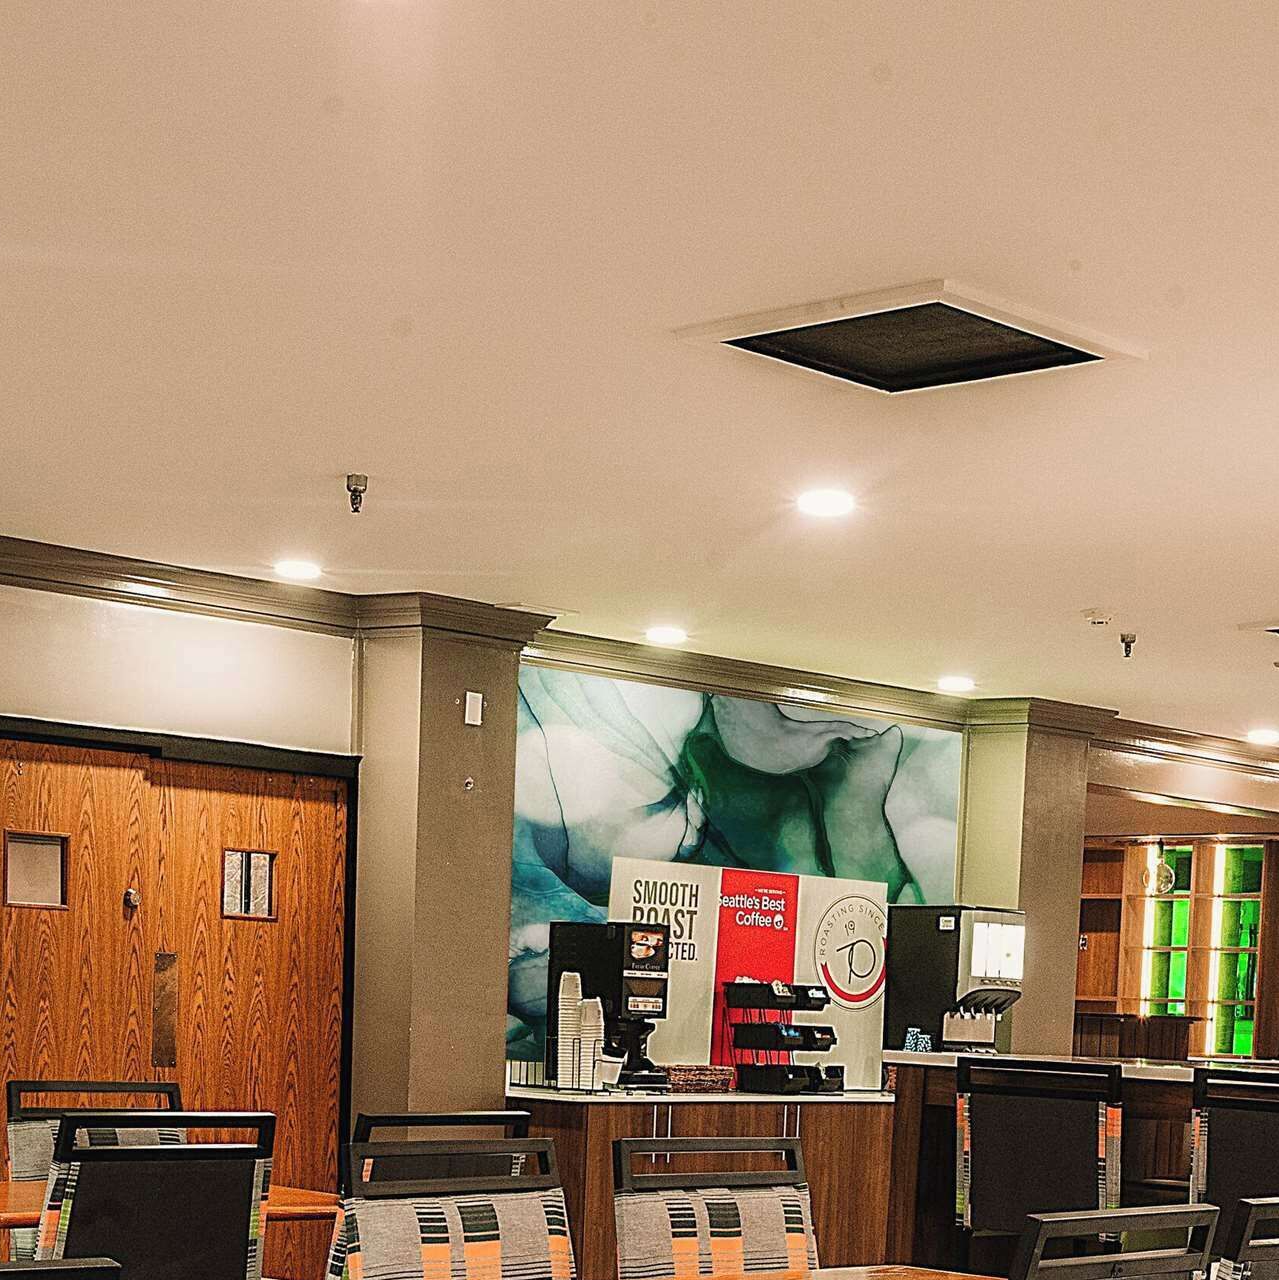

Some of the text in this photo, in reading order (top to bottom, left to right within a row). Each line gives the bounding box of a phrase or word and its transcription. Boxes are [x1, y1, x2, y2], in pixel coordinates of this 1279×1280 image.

[633, 880, 699, 908] SMOOTH
[761, 896, 785, 911] Best
[632, 906, 698, 940] ROAST
[736, 911, 772, 927] Coffee
[820, 904, 884, 956] ROASTING SINCE
[844, 920, 856, 937] 19
